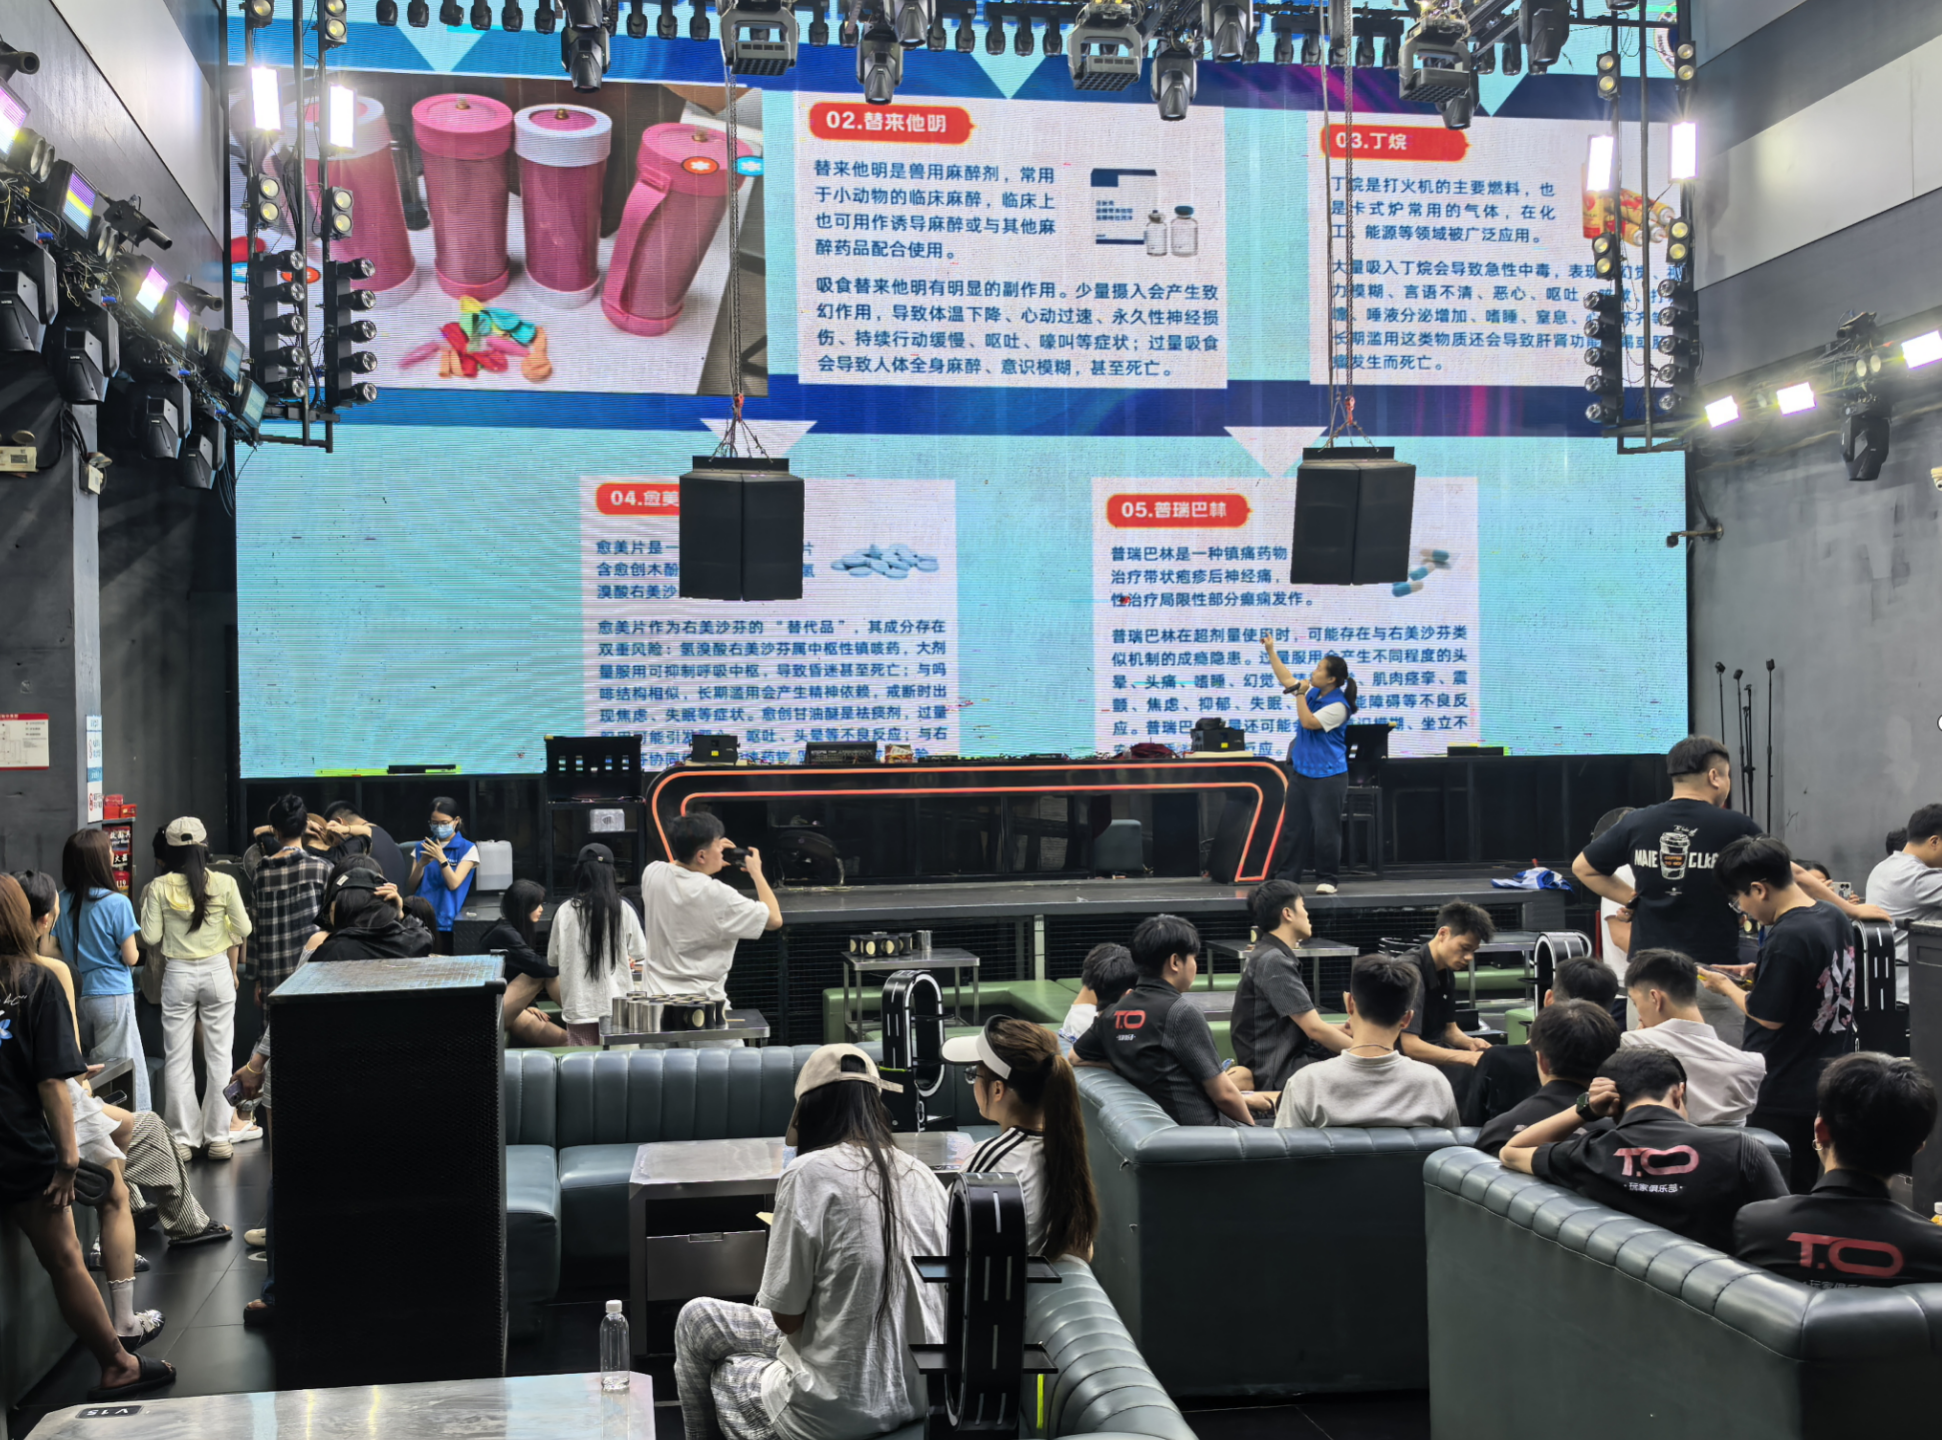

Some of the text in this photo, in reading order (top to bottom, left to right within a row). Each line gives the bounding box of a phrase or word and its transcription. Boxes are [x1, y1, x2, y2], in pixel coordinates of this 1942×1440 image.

[826, 111, 946, 133] 02.替来他明
[1335, 132, 1407, 150] 03.丁烷
[814, 160, 1055, 184] 替来他明是兽用麻醉剂，常用
[814, 187, 1055, 210] 于小动物的临床麻醉，临床上
[815, 213, 1056, 235] 也可用作诱导麻醉或与其他麻
[815, 239, 955, 259] 醉药品配合使用。
[816, 276, 1219, 300] 吸食替来他明有明显的副作用。少量摄入会产生致
[816, 303, 1219, 326] 幻作用，导致体温下降、心动过速、永久性神经损
[816, 329, 1219, 351] 伤、持续行动缓慢、呕吐、嚎叫等症状；过量吸食
[817, 355, 1172, 377] 会导致人体全身麻醉、意识模糊，甚至死亡。
[1121, 502, 1227, 518] 05.普瑞巴林
